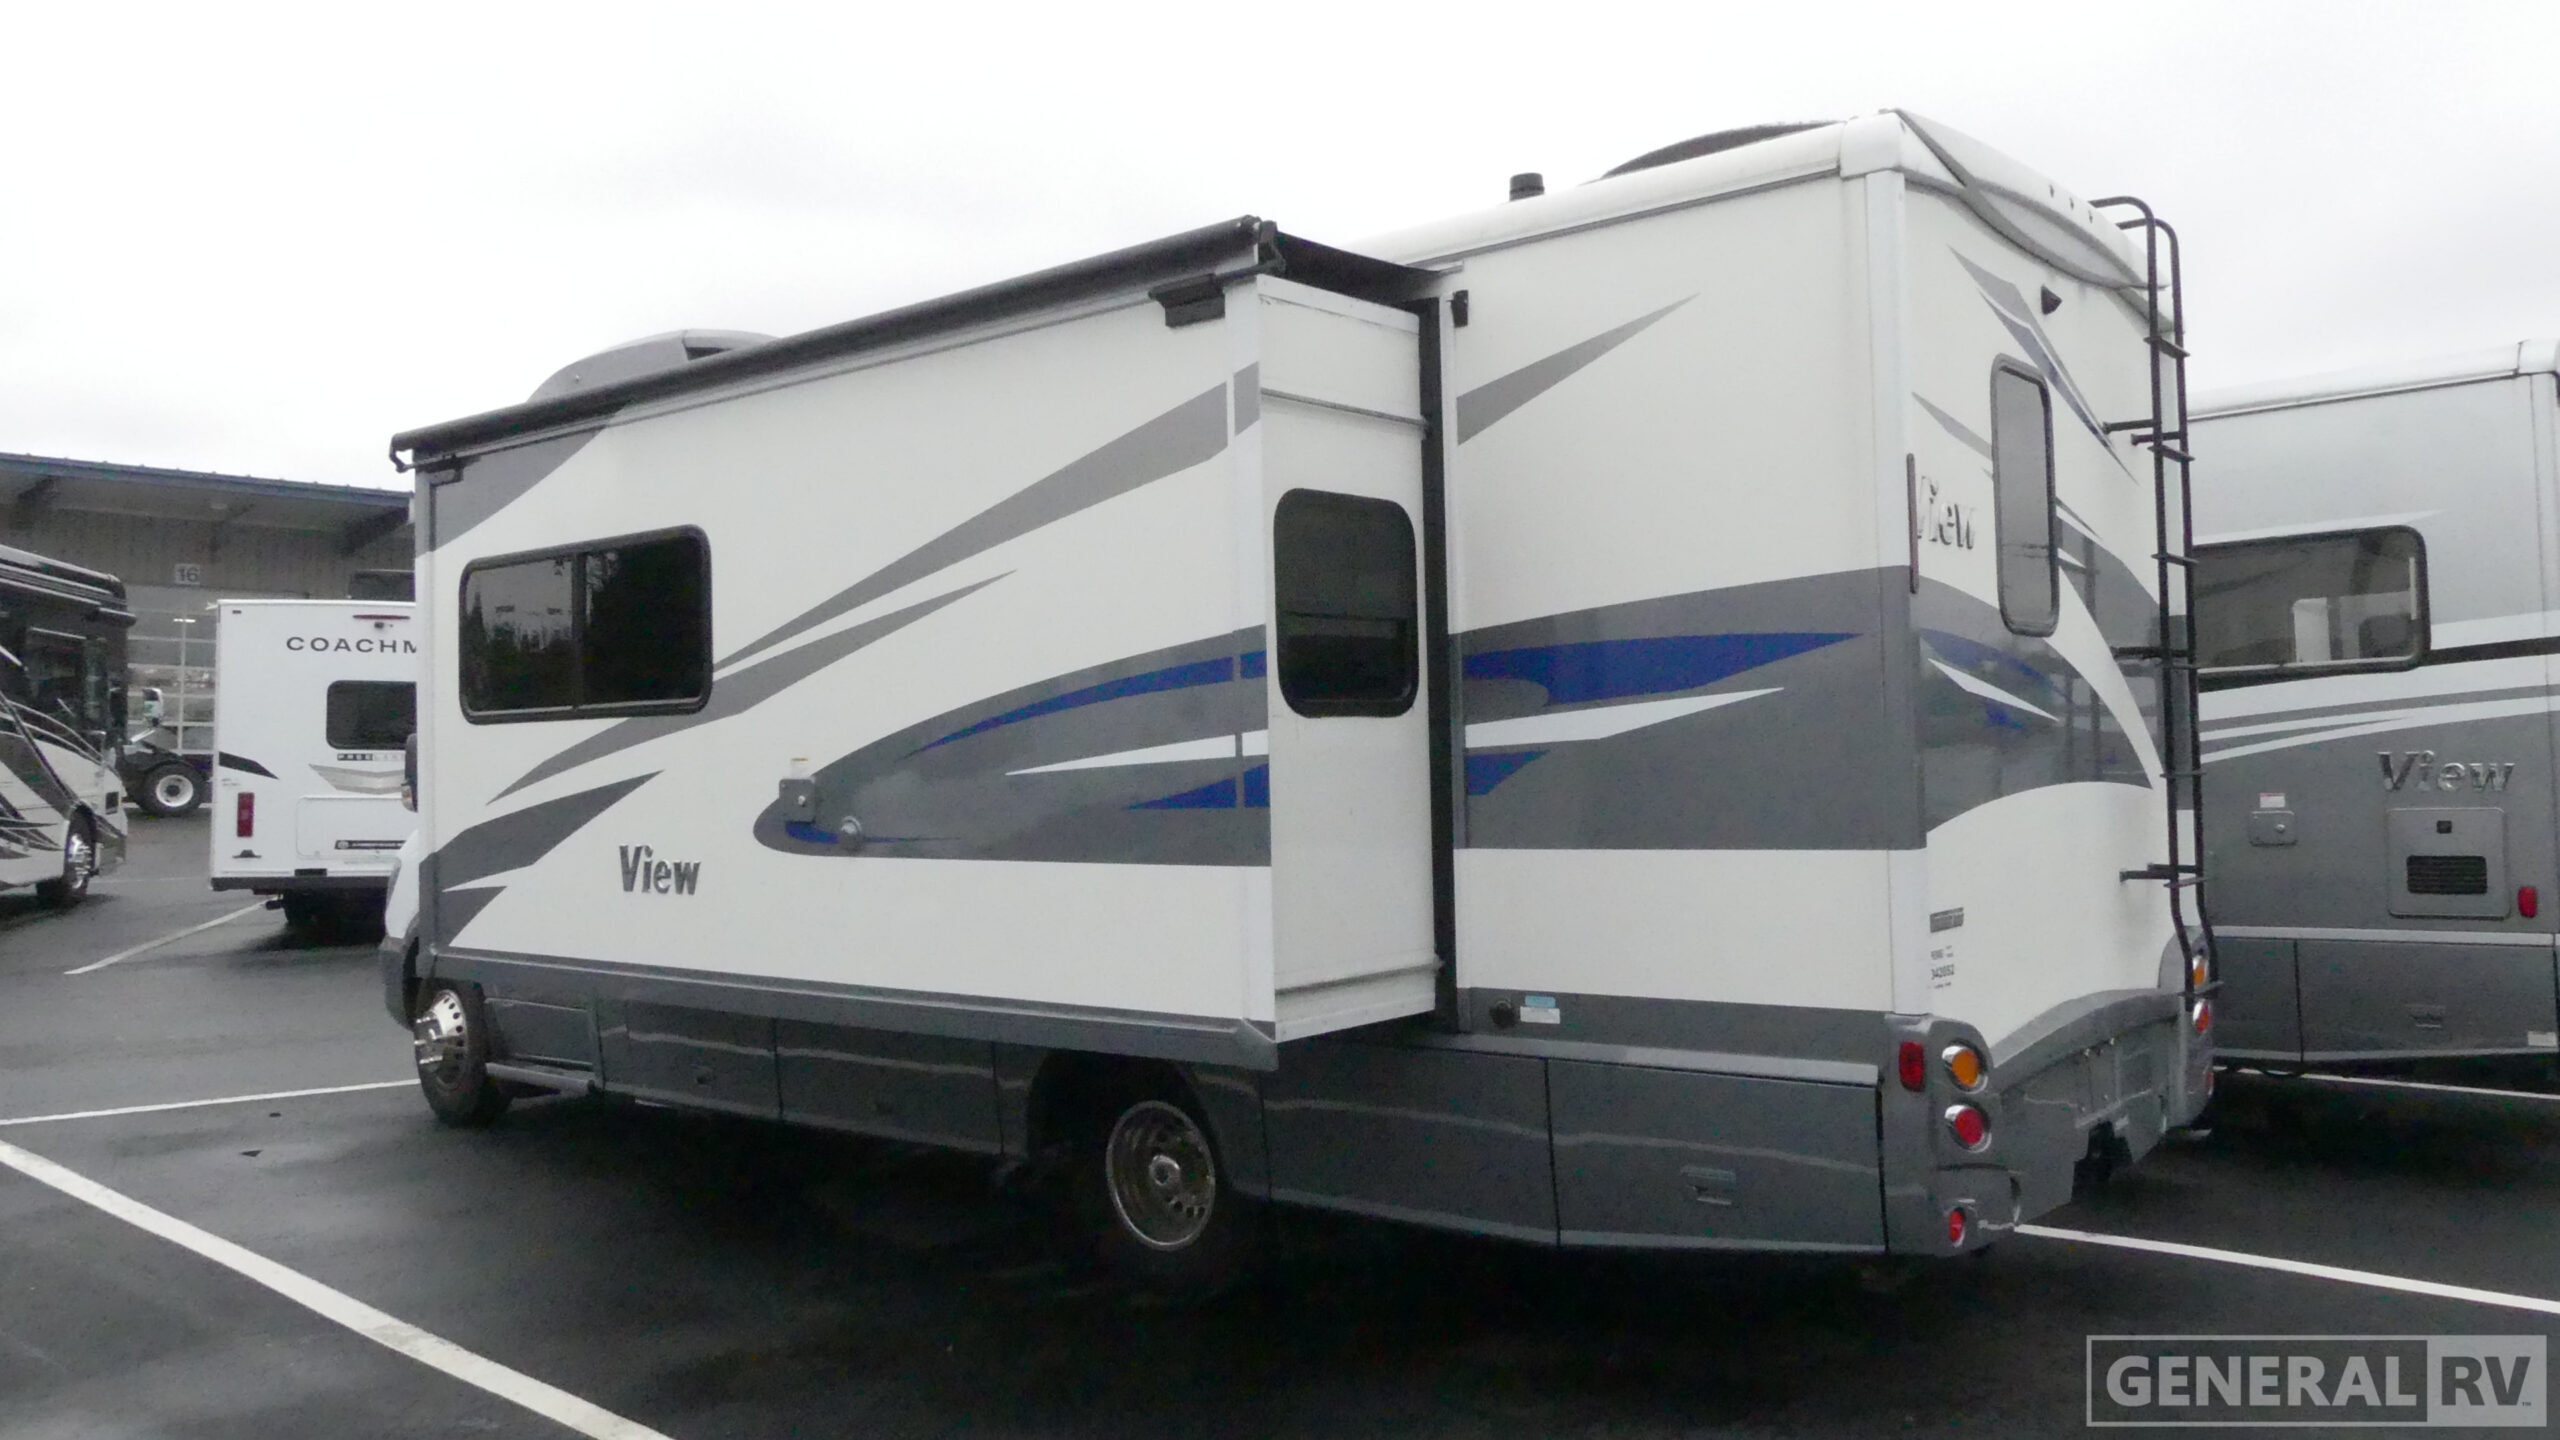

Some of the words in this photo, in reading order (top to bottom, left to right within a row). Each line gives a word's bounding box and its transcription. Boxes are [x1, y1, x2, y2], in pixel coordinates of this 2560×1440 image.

[180, 566, 199, 583] 16
[2377, 749, 2516, 792] View
[619, 844, 701, 895] View
